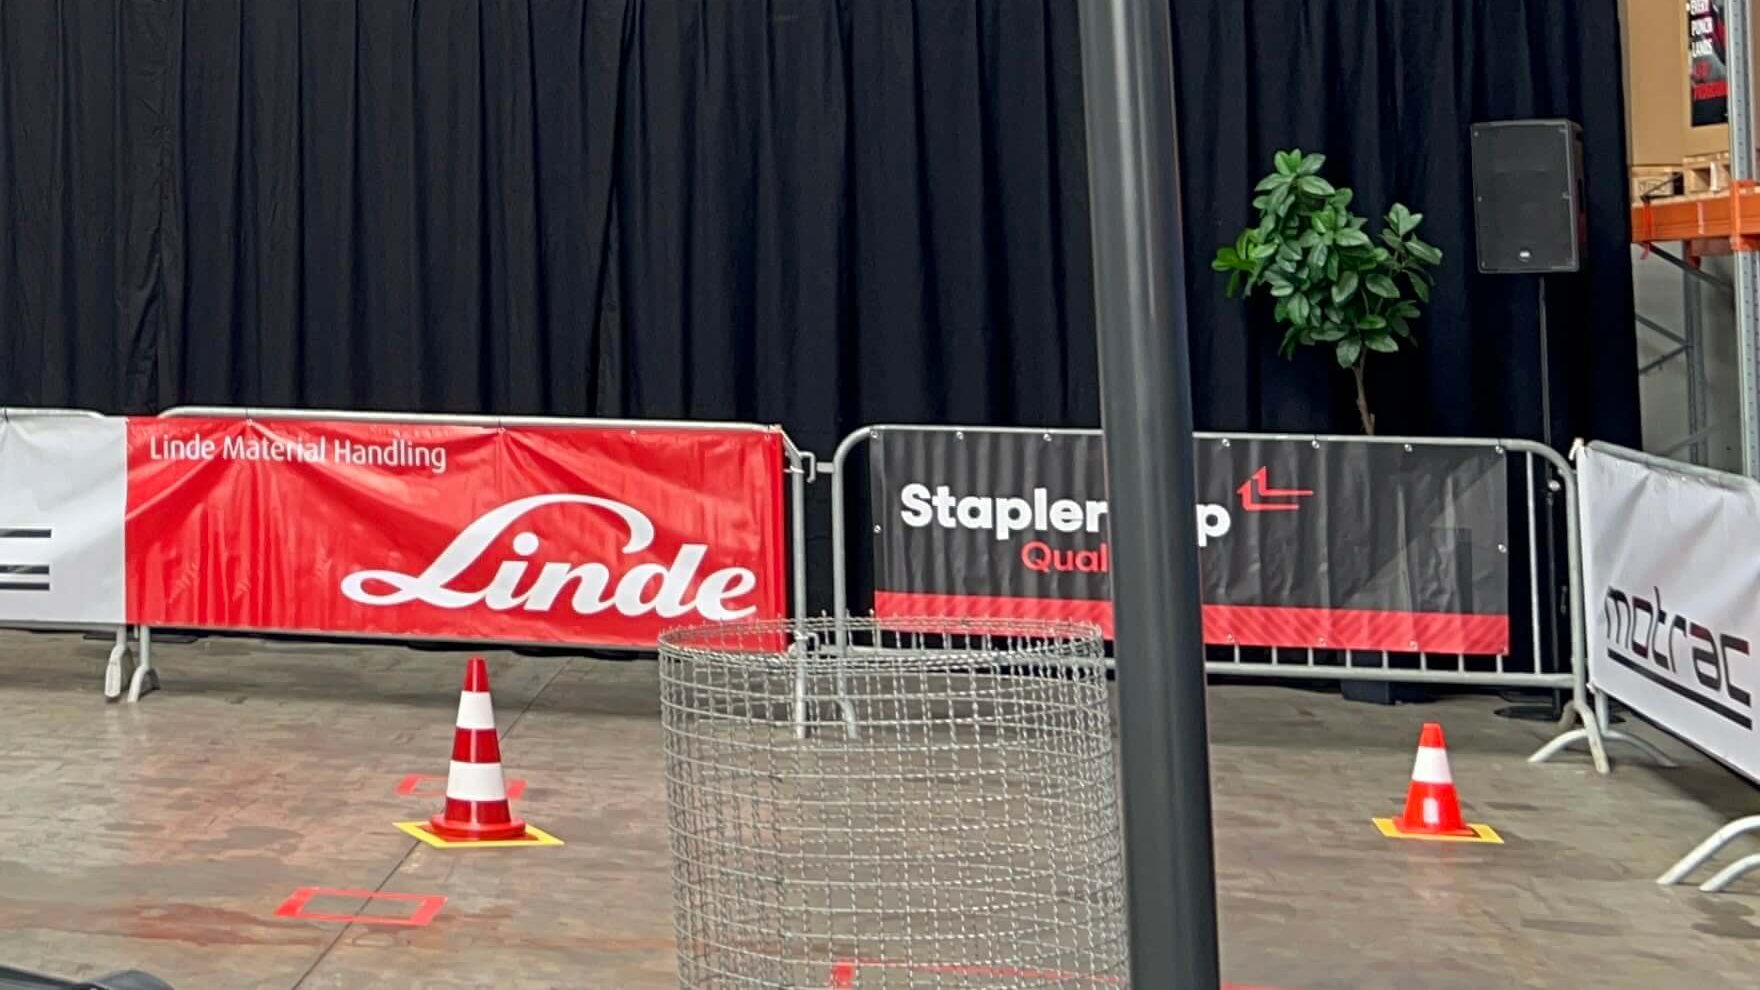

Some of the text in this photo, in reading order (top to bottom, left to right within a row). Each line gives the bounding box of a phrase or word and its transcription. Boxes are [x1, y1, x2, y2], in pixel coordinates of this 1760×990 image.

[150, 434, 447, 473] Linde Material Handling
[341, 493, 757, 620] Linde
[1604, 586, 1752, 708] motrac
